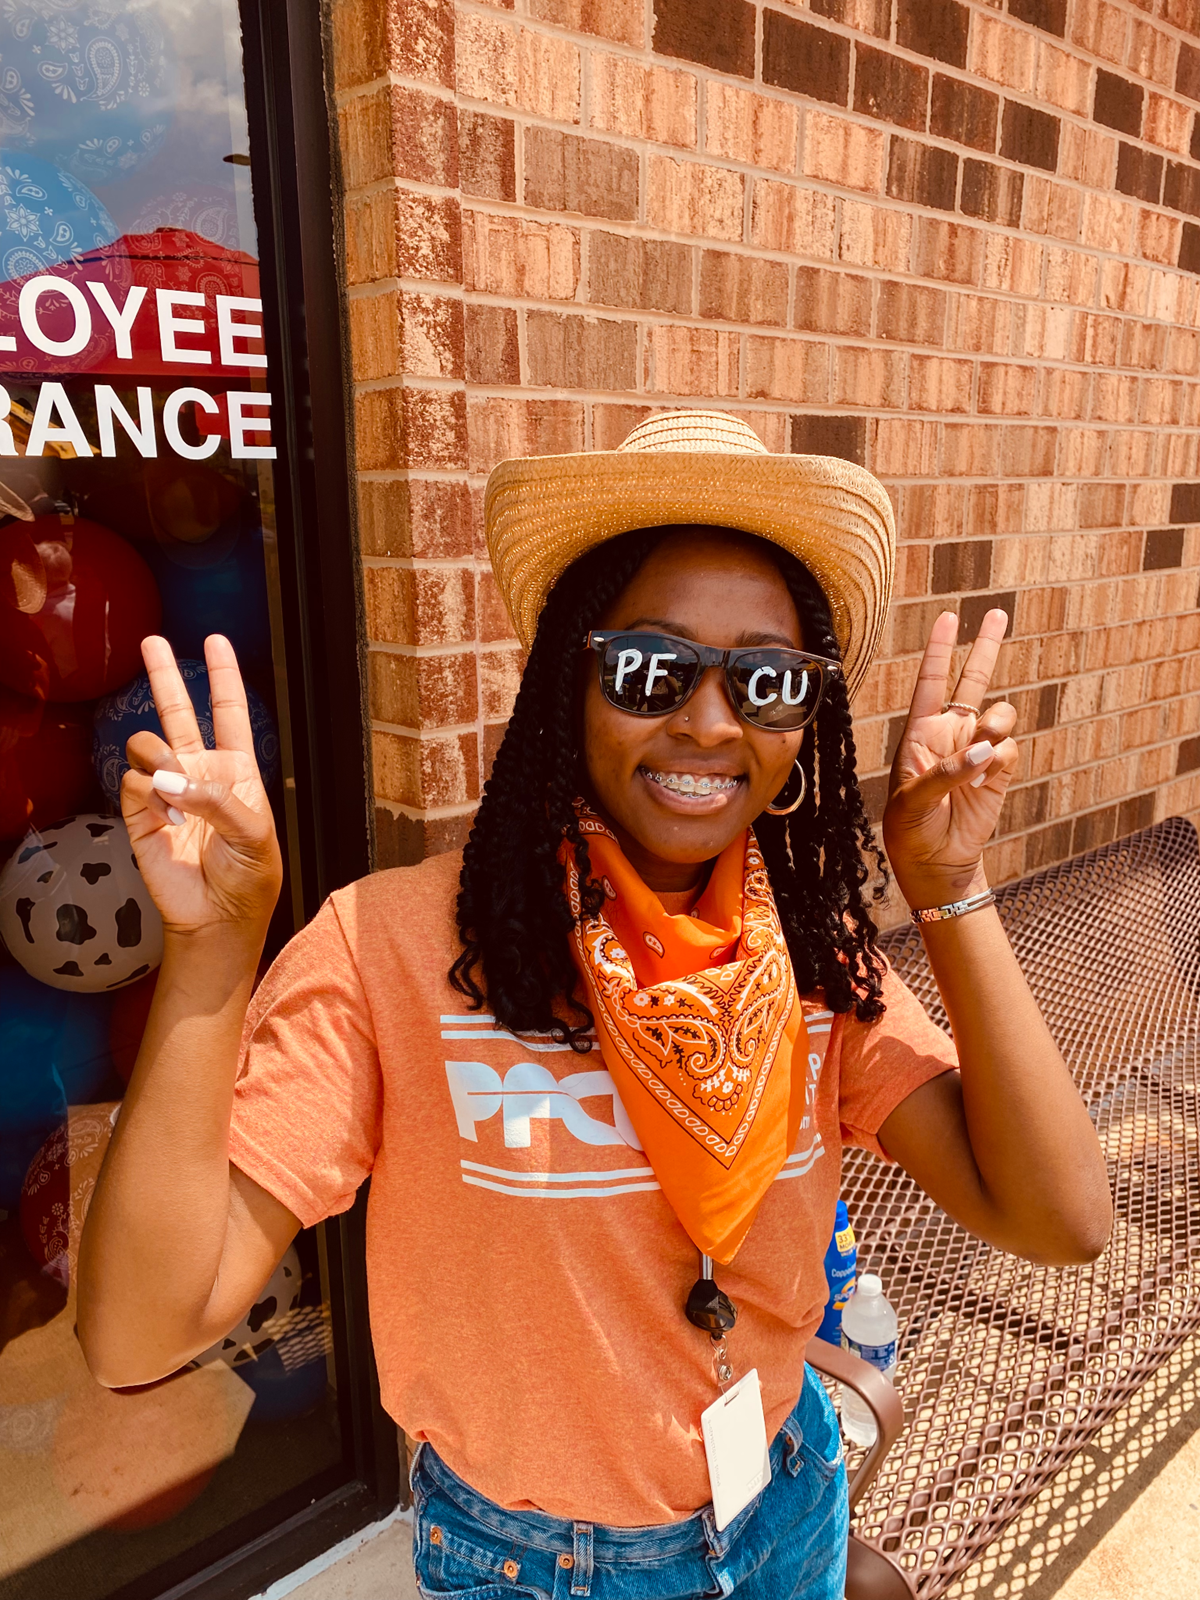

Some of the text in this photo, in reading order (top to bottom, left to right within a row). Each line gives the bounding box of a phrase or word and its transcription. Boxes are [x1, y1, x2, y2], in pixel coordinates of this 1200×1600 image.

[0, 275, 268, 368] OYEE
[615, 648, 808, 706] PF CU
